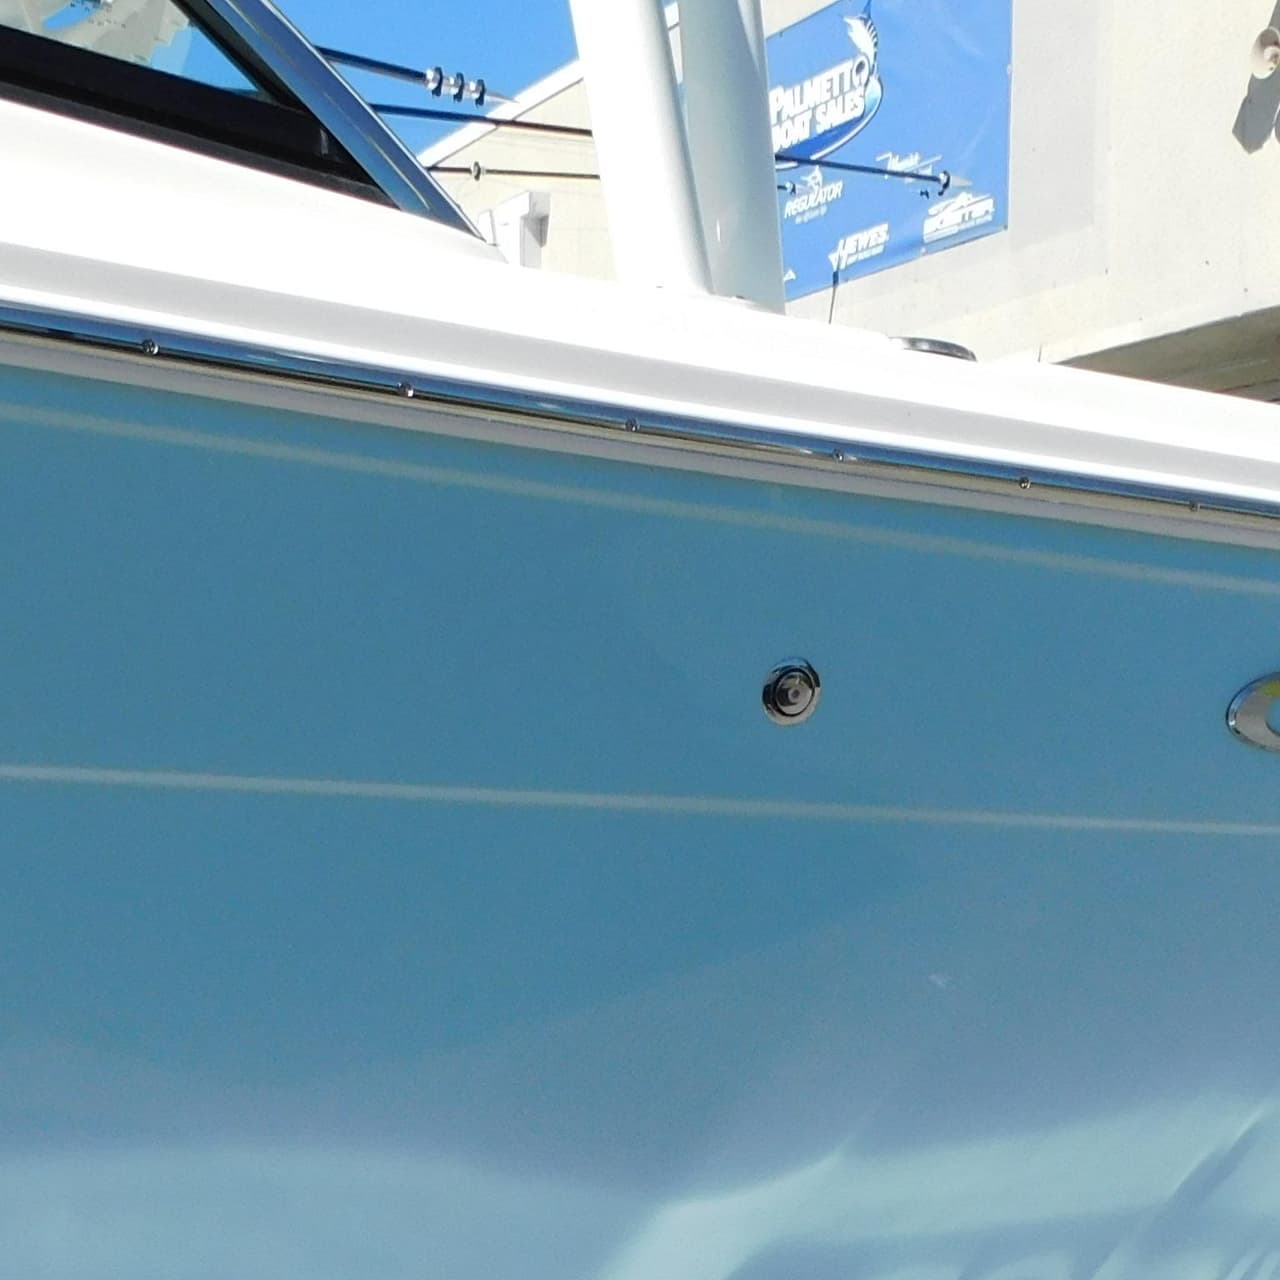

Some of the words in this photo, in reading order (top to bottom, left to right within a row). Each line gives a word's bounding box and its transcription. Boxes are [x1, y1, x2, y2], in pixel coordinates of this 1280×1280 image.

[769, 55, 870, 126] PALMETTO
[815, 86, 865, 134] SALES
[784, 181, 843, 219] REGULATOR
